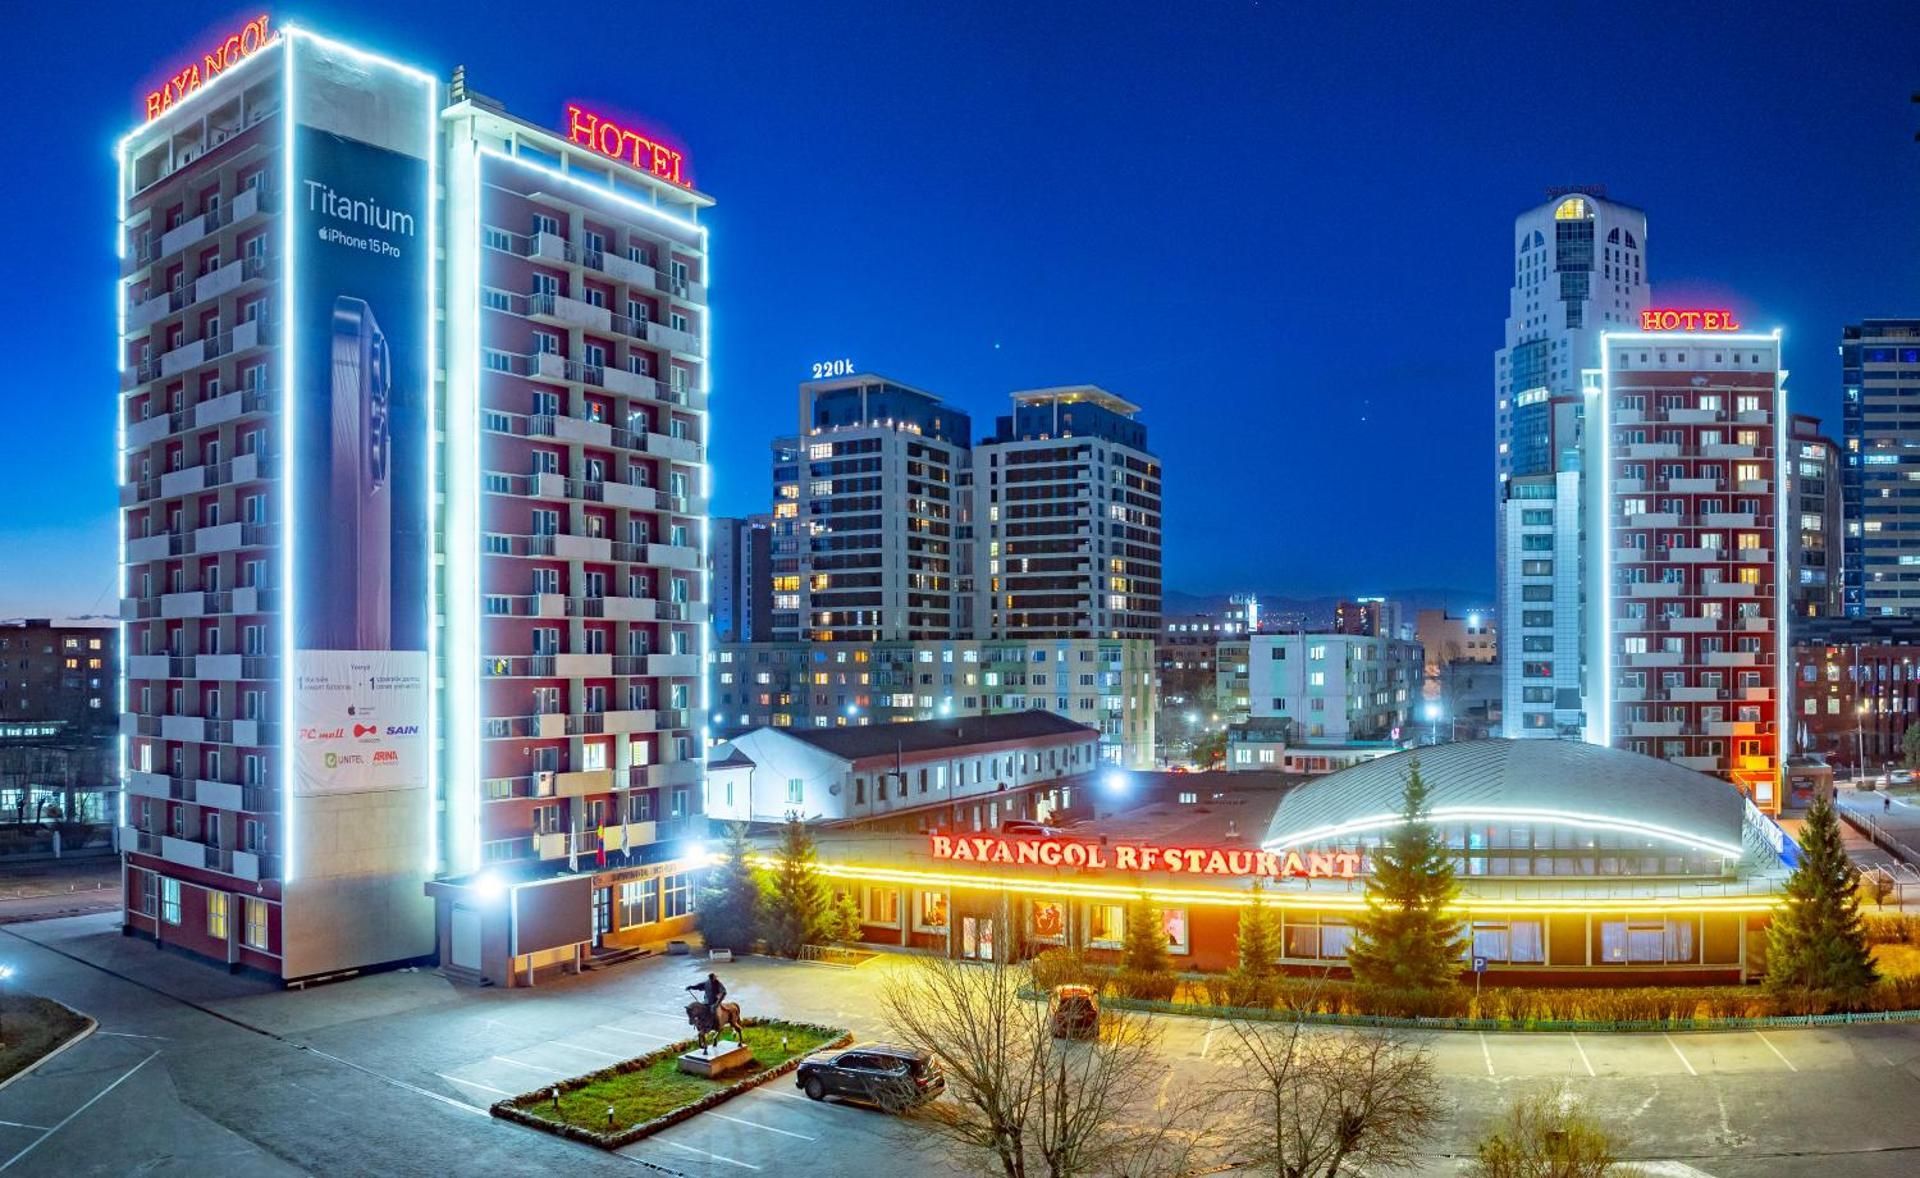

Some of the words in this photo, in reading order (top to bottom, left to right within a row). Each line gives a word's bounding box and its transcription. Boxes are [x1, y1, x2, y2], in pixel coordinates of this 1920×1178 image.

[145, 14, 280, 122] BAYANGOL
[568, 105, 691, 189] HOTEL
[303, 179, 415, 237] Titanium
[328, 227, 367, 250] iPhone
[368, 238, 381, 253] 15
[382, 241, 401, 258] Pro
[1642, 310, 1740, 331] HOTEL
[812, 357, 855, 380] 220k
[385, 725, 419, 736] SAIN
[337, 754, 365, 765] UNITEL
[932, 836, 1106, 868] BAYANGOL
[1473, 958, 1484, 972] P
